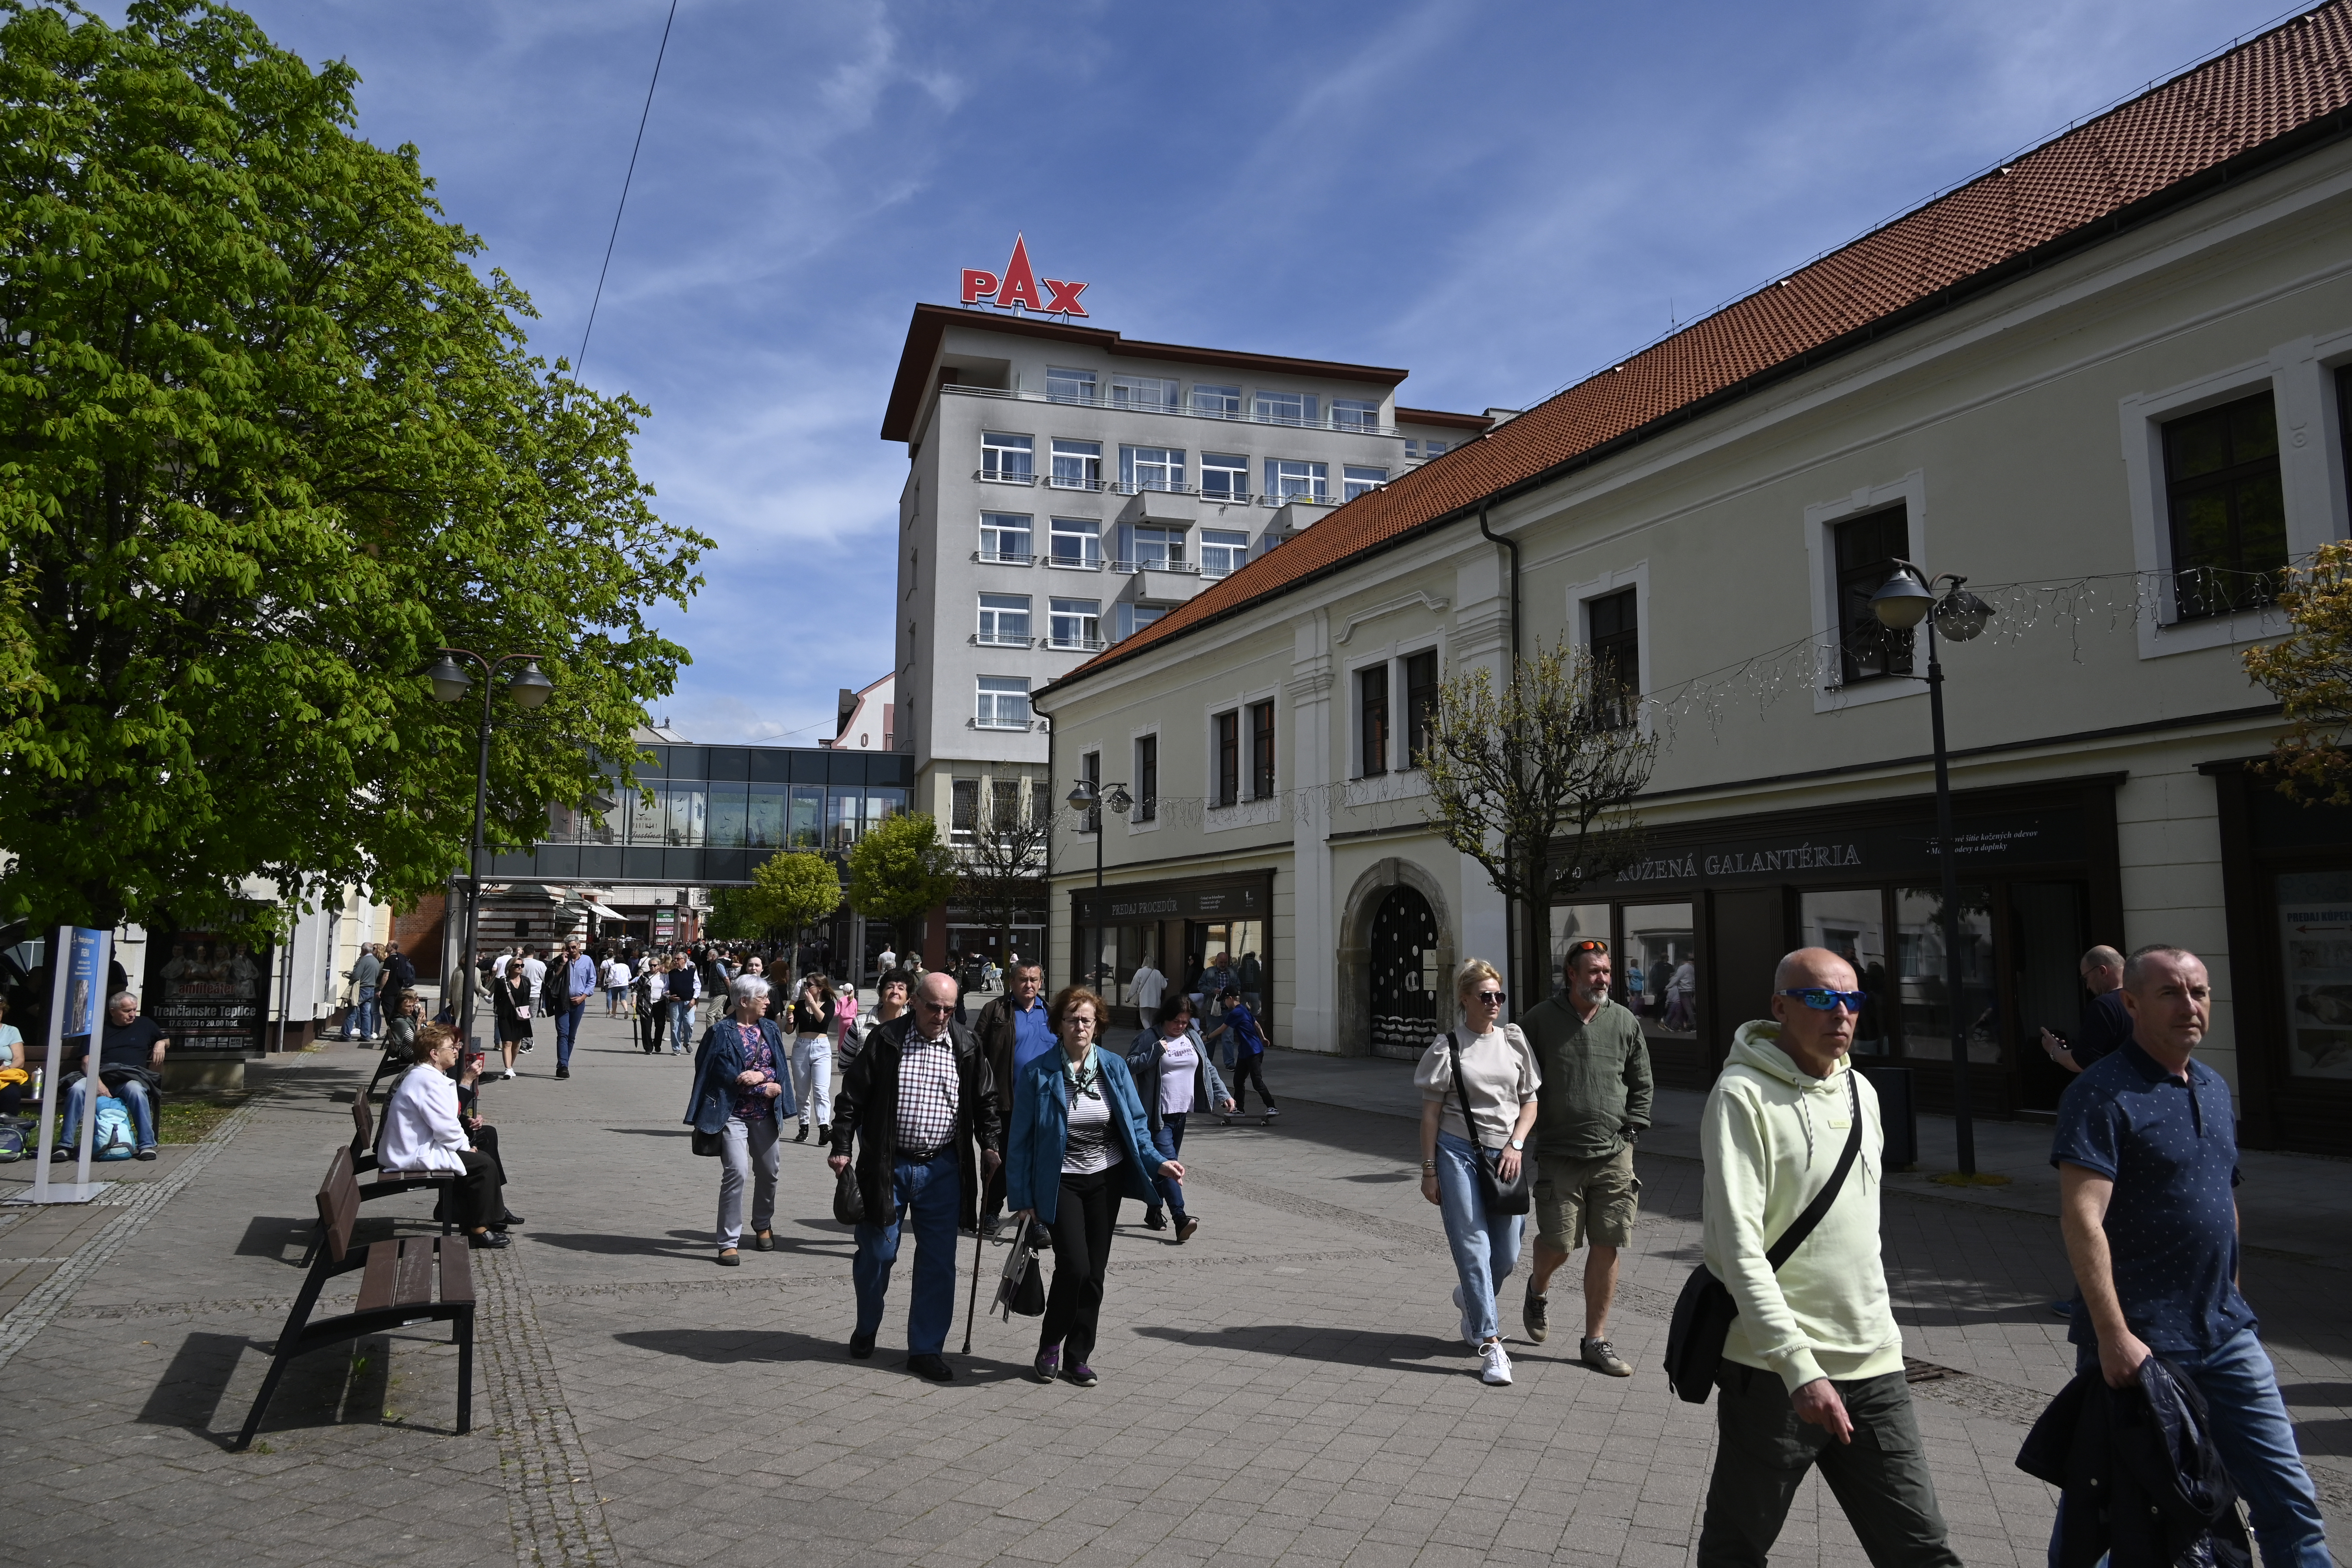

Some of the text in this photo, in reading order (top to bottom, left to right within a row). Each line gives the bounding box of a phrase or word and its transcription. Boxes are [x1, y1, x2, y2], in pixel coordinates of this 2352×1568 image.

[961, 229, 1089, 318] PAX
[1981, 831, 2012, 841] kožených
[1954, 845, 1973, 853] odevy
[1980, 842, 2007, 851] doplnky
[1705, 842, 1861, 875] GALANTÉRIA
[1112, 898, 1177, 915] PREDAJ PROCEDÚR
[2287, 912, 2319, 922] PREDAJ
[179, 982, 236, 994] amfiteáter
[154, 1005, 256, 1017] Trenčianske Teplice
